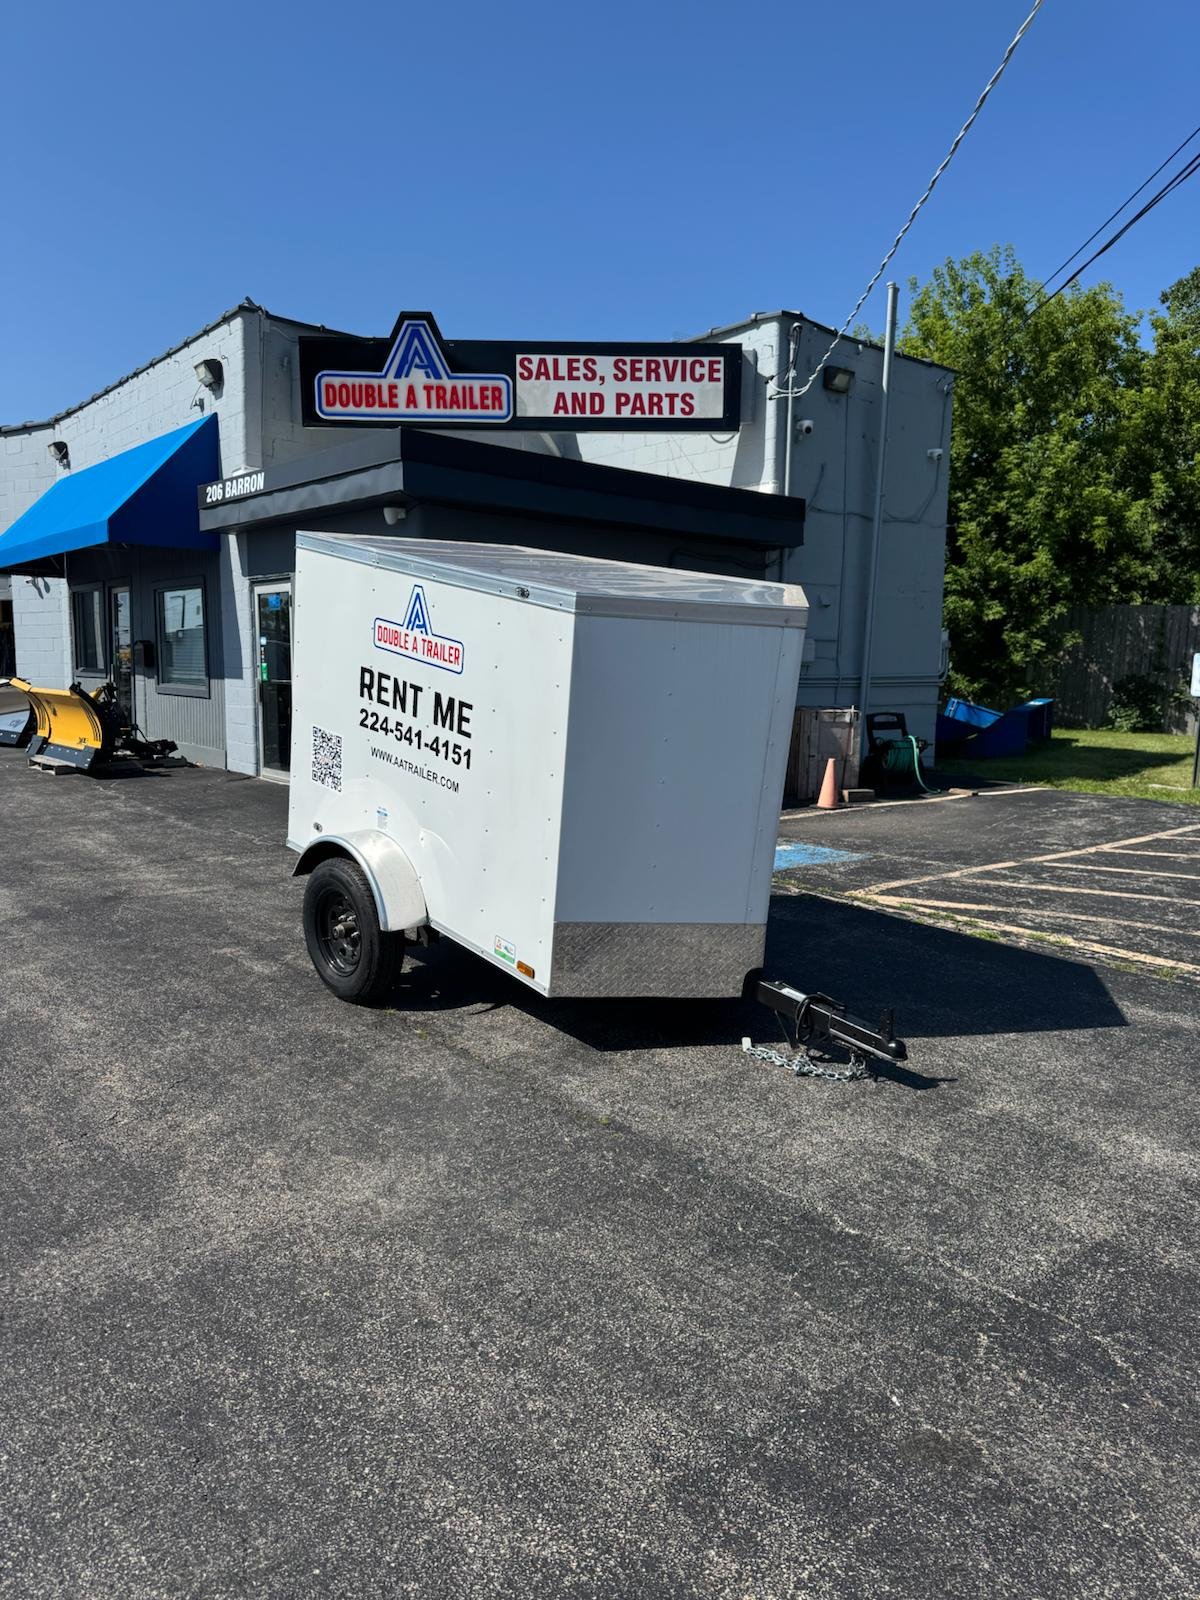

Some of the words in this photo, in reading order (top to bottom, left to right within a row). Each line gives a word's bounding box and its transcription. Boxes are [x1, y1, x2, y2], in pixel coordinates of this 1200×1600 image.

[518, 357, 605, 385] SALES,
[613, 358, 721, 383] SERVICE
[324, 383, 399, 408] DOUBLE
[405, 384, 418, 409] A
[423, 385, 503, 411] TRAILER
[553, 392, 605, 415] AND
[615, 392, 695, 416] PARTS
[206, 483, 223, 503] 206
[225, 472, 265, 498] BARRON
[377, 625, 410, 651] DOUBLE
[411, 636, 419, 654] A
[421, 638, 460, 666] TRAILER
[359, 666, 424, 718] RENT
[433, 691, 474, 739] ME
[359, 708, 472, 770] 224-541-4151
[370, 746, 460, 793] WWW.AATRAILER.COM
